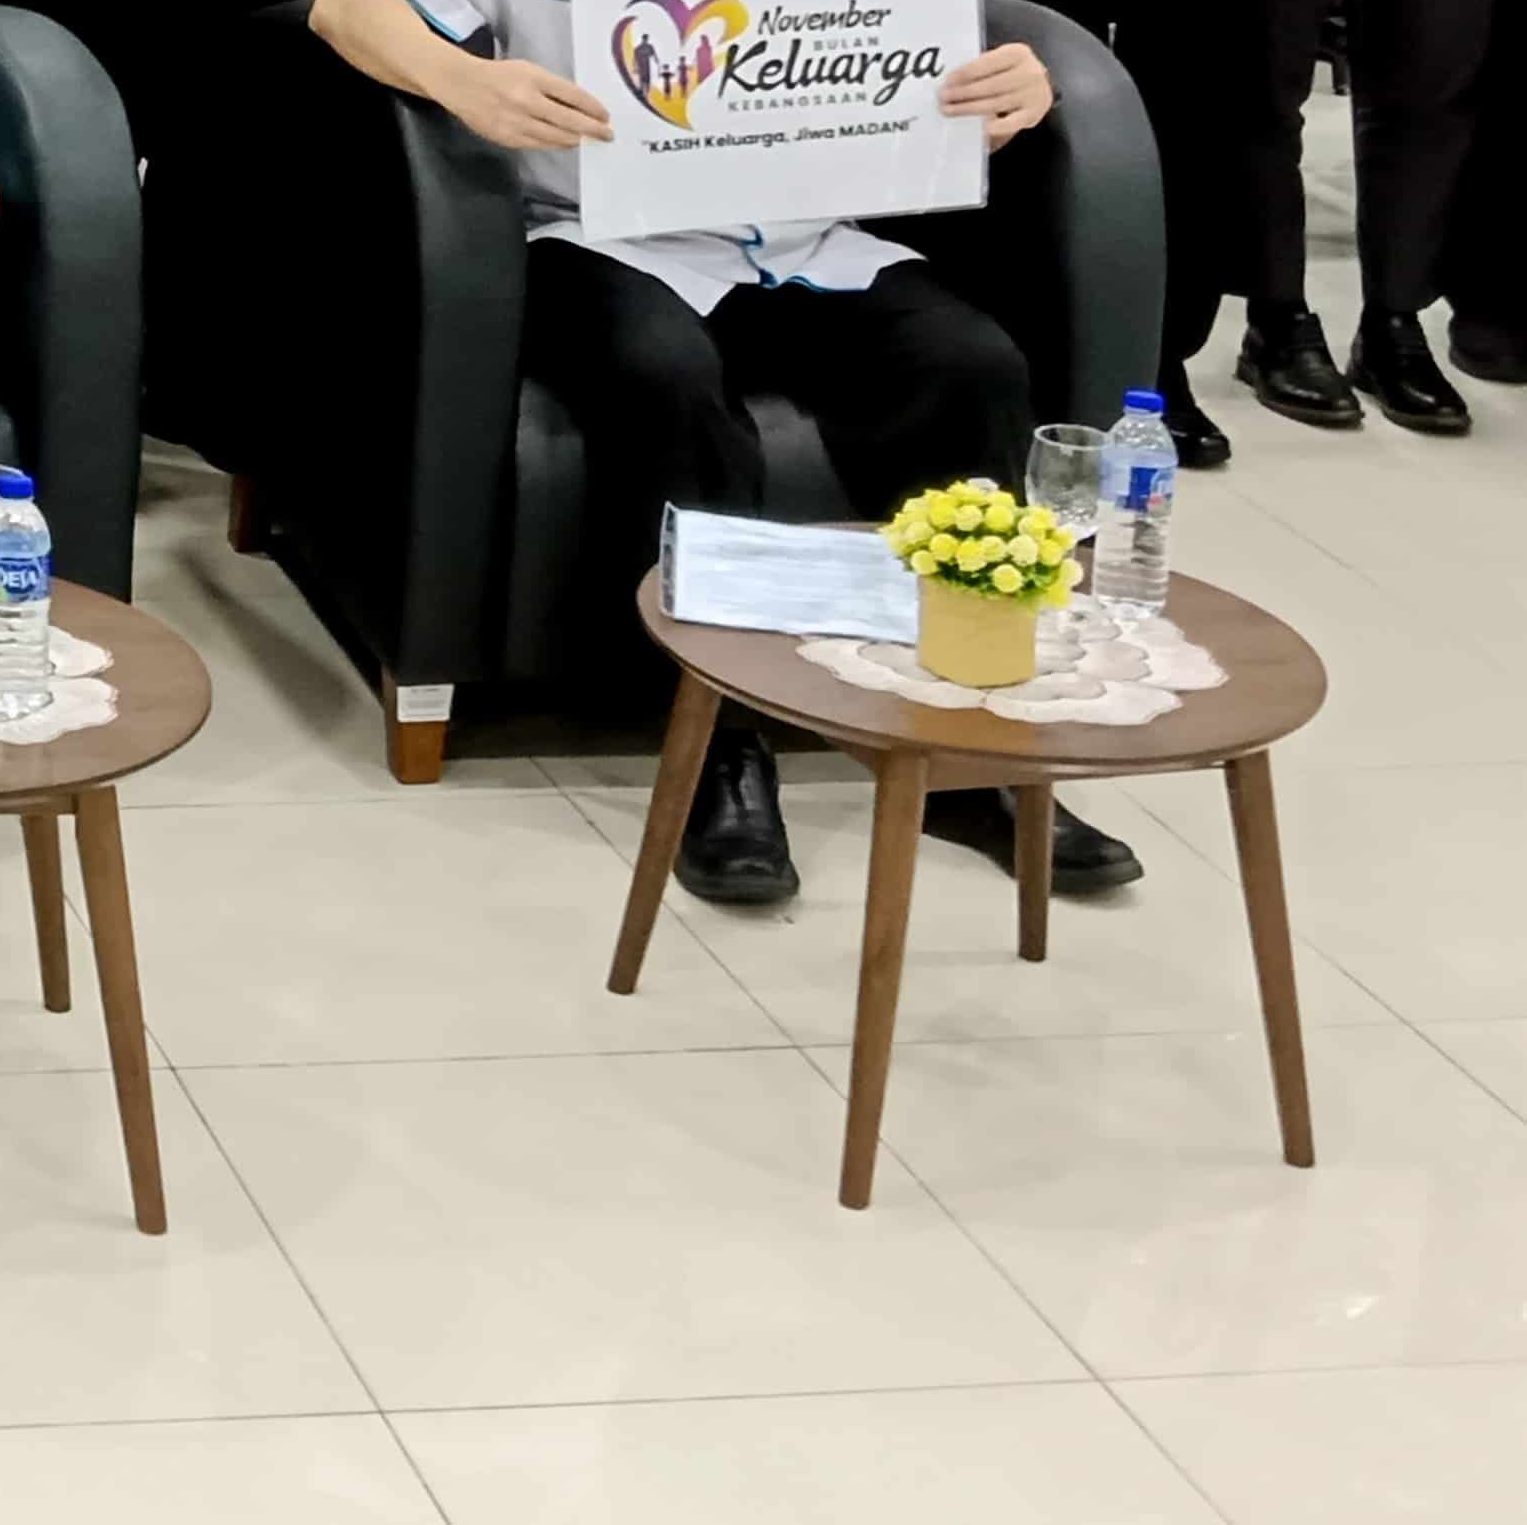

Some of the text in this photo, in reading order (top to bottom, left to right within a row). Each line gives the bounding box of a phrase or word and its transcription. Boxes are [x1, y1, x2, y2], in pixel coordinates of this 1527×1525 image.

[757, 0, 891, 36] November
[814, 36, 880, 52] BULAN
[718, 38, 944, 106] Keluarga
[727, 92, 867, 111] KEBANGSAAN
[704, 131, 790, 148] Keluarga,
[794, 127, 835, 141] Jiwa
